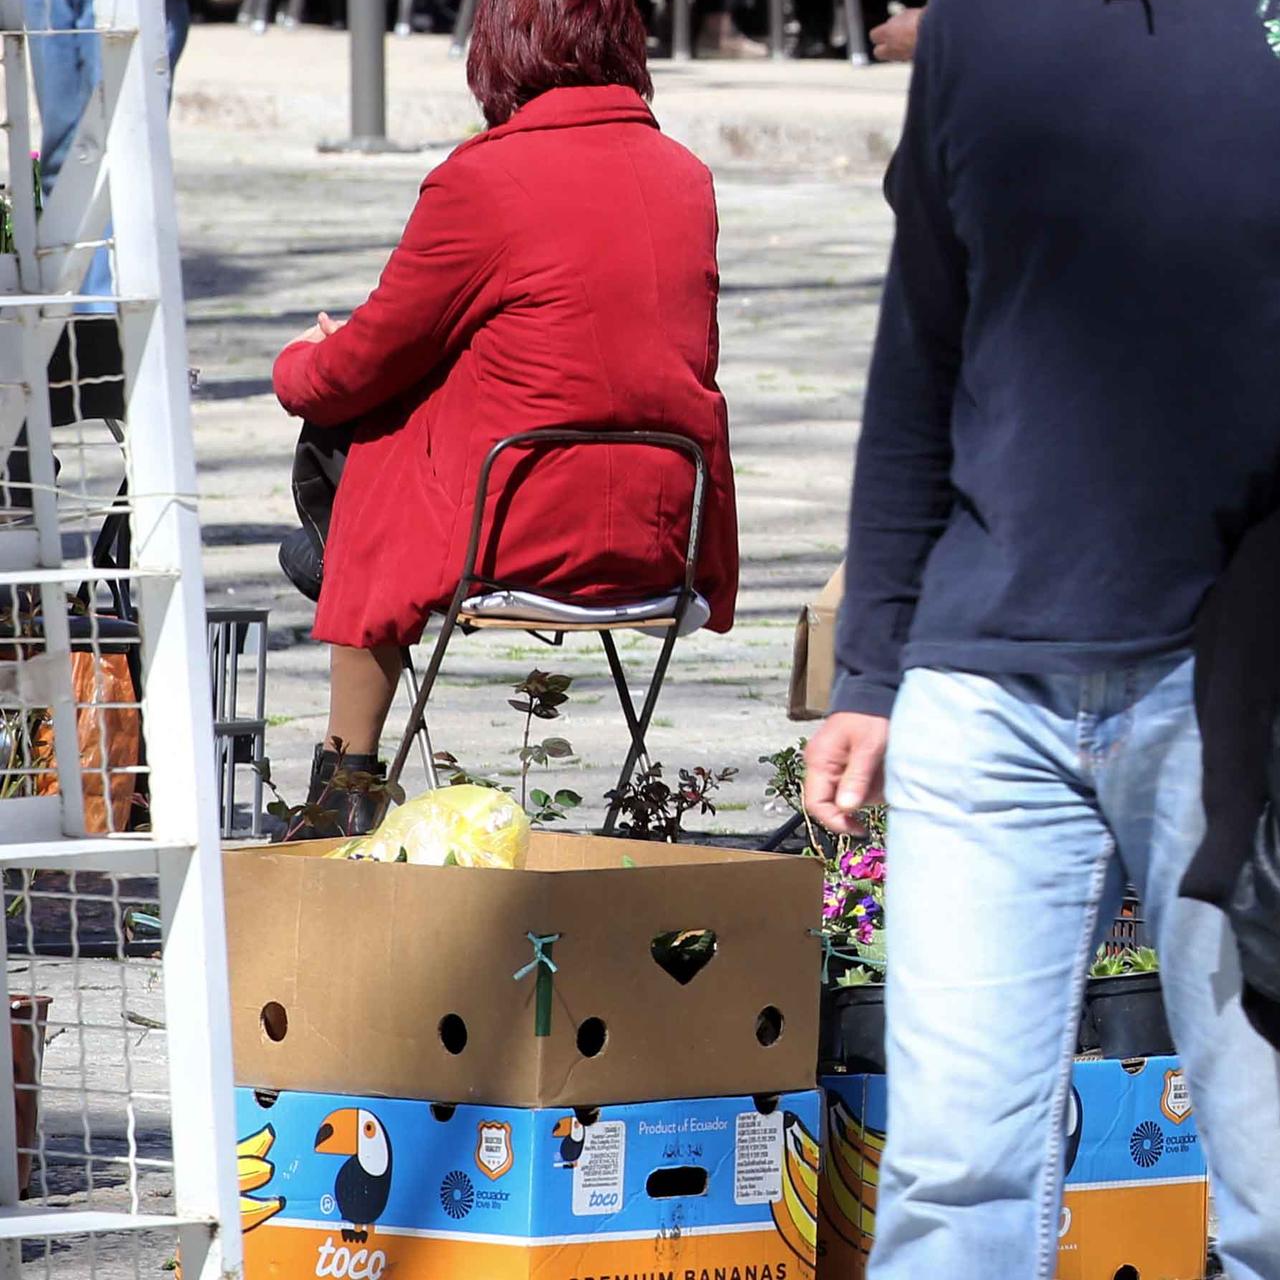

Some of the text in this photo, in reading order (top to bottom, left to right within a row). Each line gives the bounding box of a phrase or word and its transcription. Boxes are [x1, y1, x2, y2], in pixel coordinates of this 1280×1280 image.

[638, 1116, 728, 1136] Product of Ecuador
[1165, 1133, 1198, 1145] ecuador
[476, 1189, 511, 1201] ecuador
[589, 1189, 619, 1208] toco
[314, 1237, 386, 1280] toco
